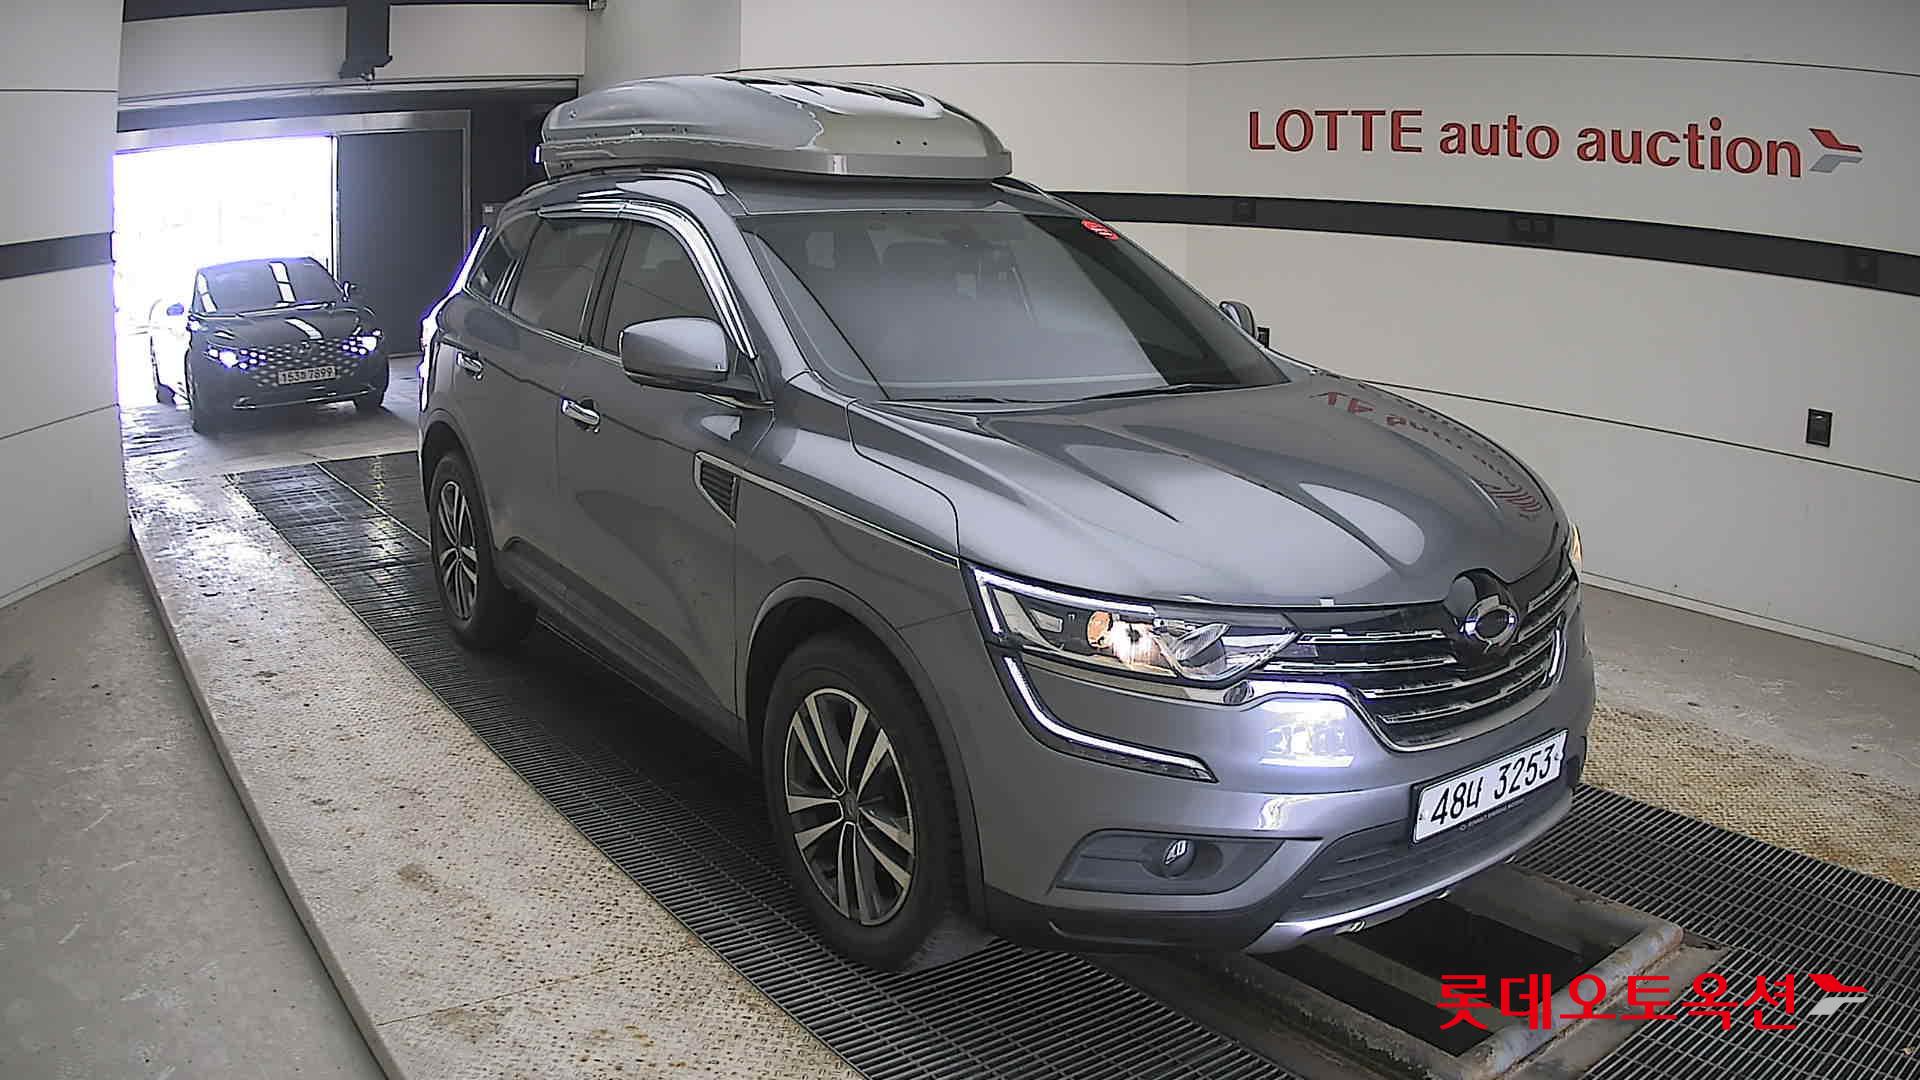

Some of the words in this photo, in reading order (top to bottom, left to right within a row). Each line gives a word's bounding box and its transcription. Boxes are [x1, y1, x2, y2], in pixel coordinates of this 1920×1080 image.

[1248, 109, 1424, 153] LOTTE
[1438, 114, 1561, 161] auto
[1576, 116, 1804, 179] auction
[1430, 776, 1484, 826] 48나
[1493, 743, 1556, 800] 3253
